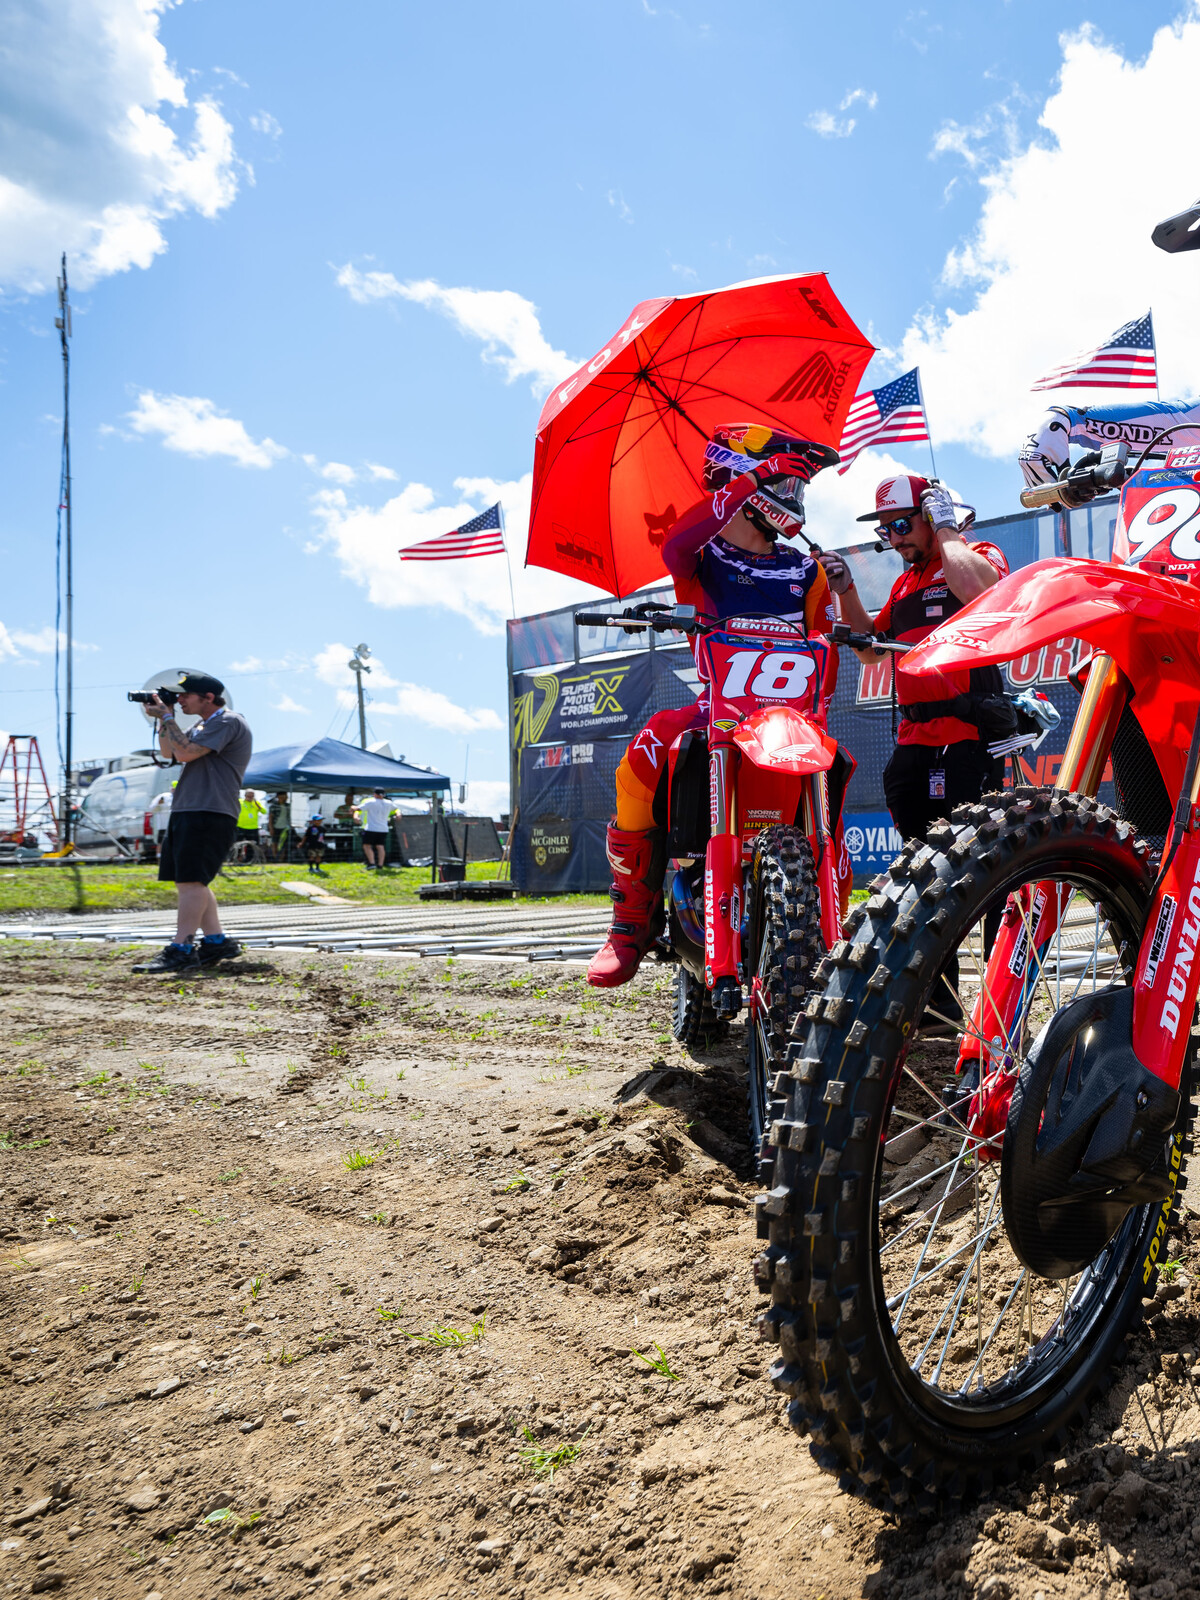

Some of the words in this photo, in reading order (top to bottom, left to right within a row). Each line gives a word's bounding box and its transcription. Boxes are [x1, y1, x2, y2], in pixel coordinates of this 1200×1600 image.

[558, 315, 645, 403] FOX
[1086, 418, 1173, 446] HONDA
[750, 494, 790, 527] dBull
[708, 541, 814, 580] inestas
[1168, 563, 1197, 572] NDA
[721, 651, 816, 699] 18
[561, 682, 596, 697] SUPER
[560, 703, 595, 716] CROSS
[563, 694, 595, 706] MOTO
[561, 720, 584, 729] WORLD
[584, 714, 628, 727] CHAMPIONSHIP
[532, 745, 571, 769] AMA
[572, 744, 594, 757] PRO
[770, 756, 821, 766] HONDA
[743, 822, 778, 830] HINS
[705, 870, 715, 959] DUNLOP
[1150, 894, 1173, 962] WISECO
